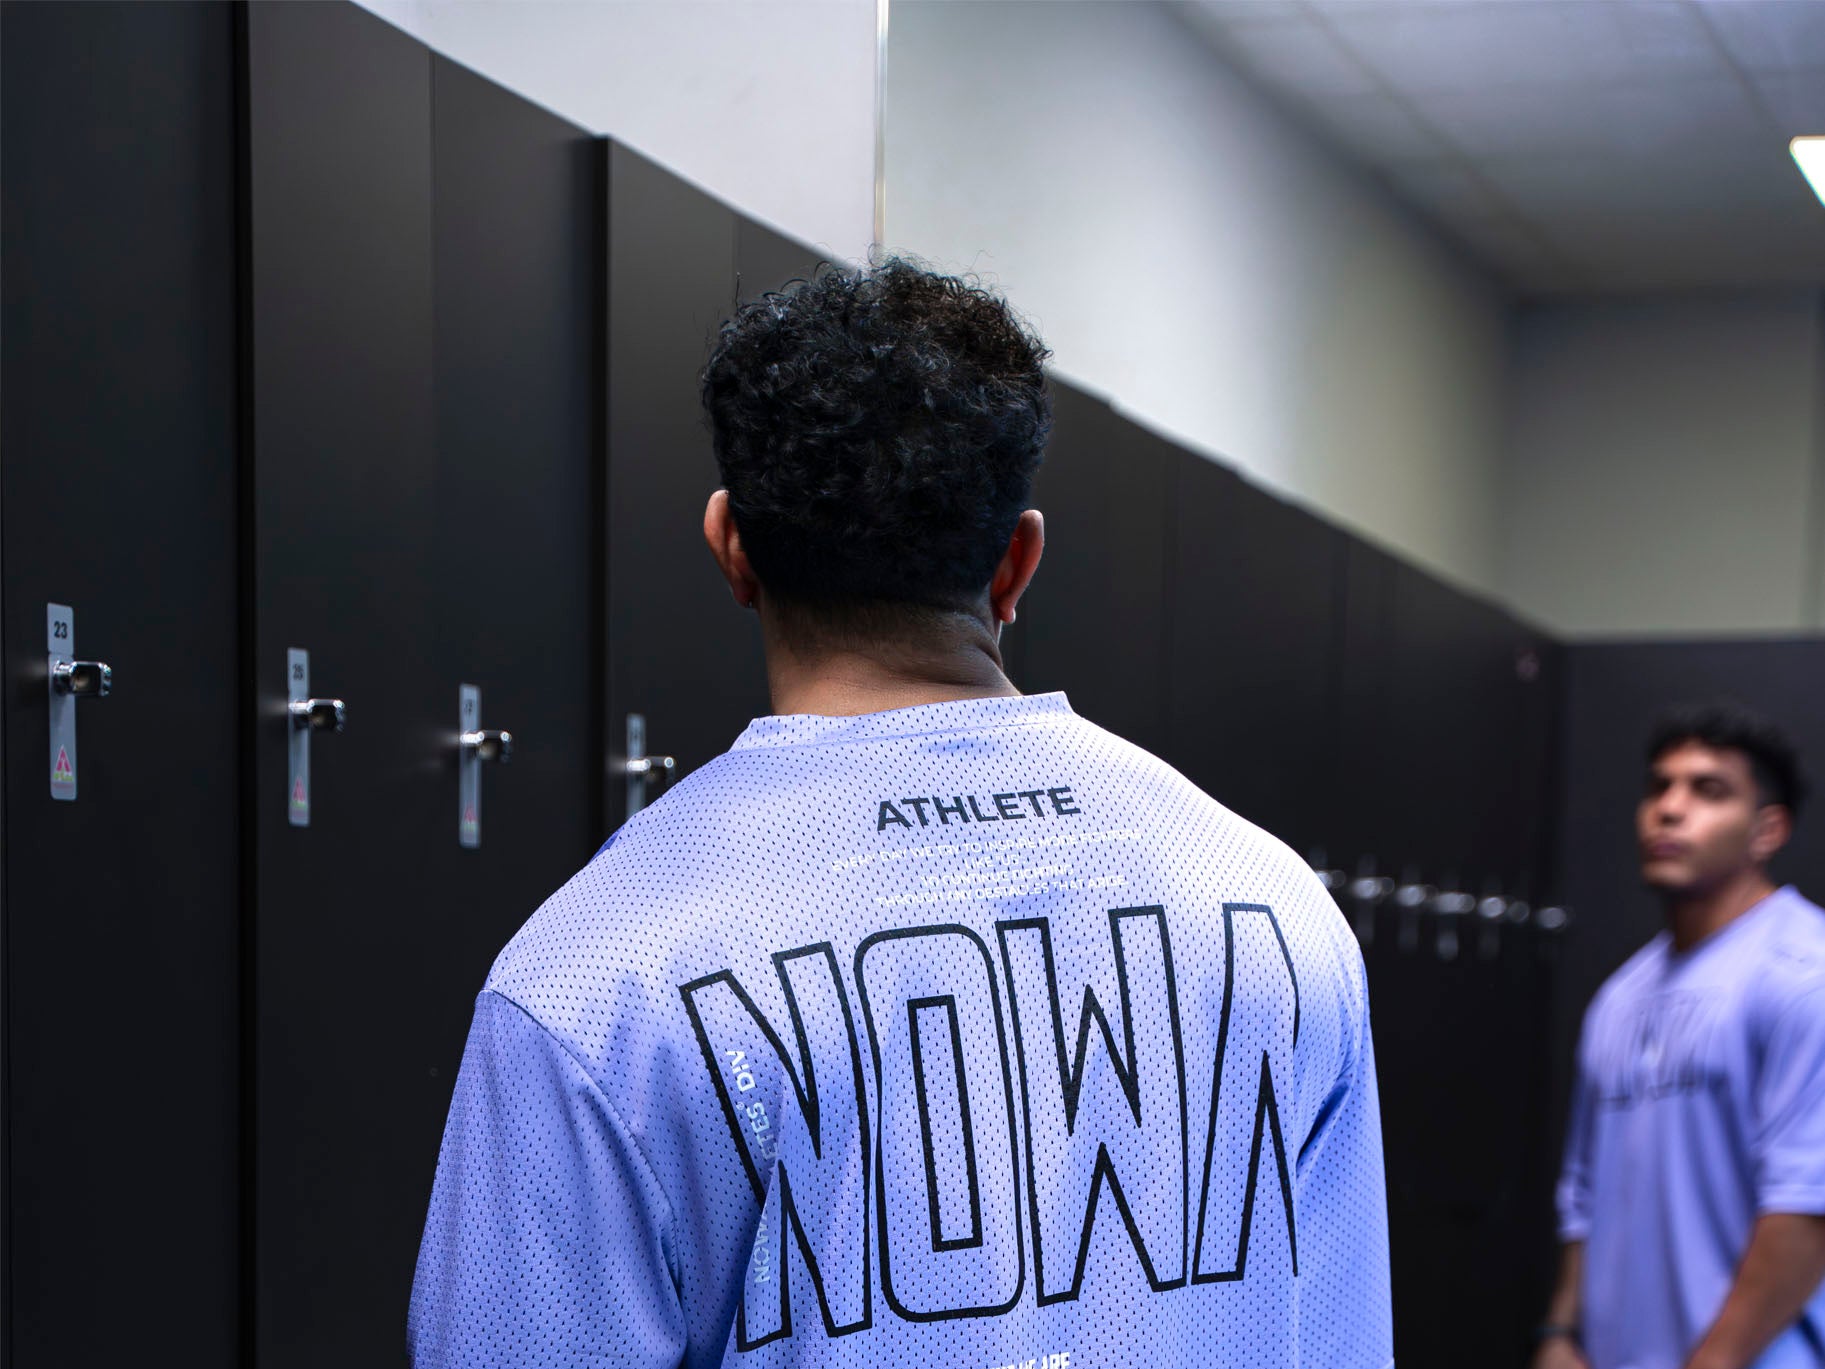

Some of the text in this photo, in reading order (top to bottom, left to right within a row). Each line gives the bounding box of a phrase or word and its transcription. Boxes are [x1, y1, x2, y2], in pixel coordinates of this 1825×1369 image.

[54, 621, 68, 639] 23
[877, 787, 1081, 831] ATHLETE
[832, 828, 1142, 871] EVERY DAY WE TRY TO INSPIRE MORE FIGHTERS
[965, 855, 994, 869] LIKE
[921, 864, 1073, 888] TO CONTINUE FIGHTING
[876, 890, 943, 908] THROUGH
[947, 889, 972, 901] ANY
[975, 882, 1051, 899] OBSTACLES
[1053, 878, 1084, 892] THAT
[725, 1049, 756, 1093] DIV
